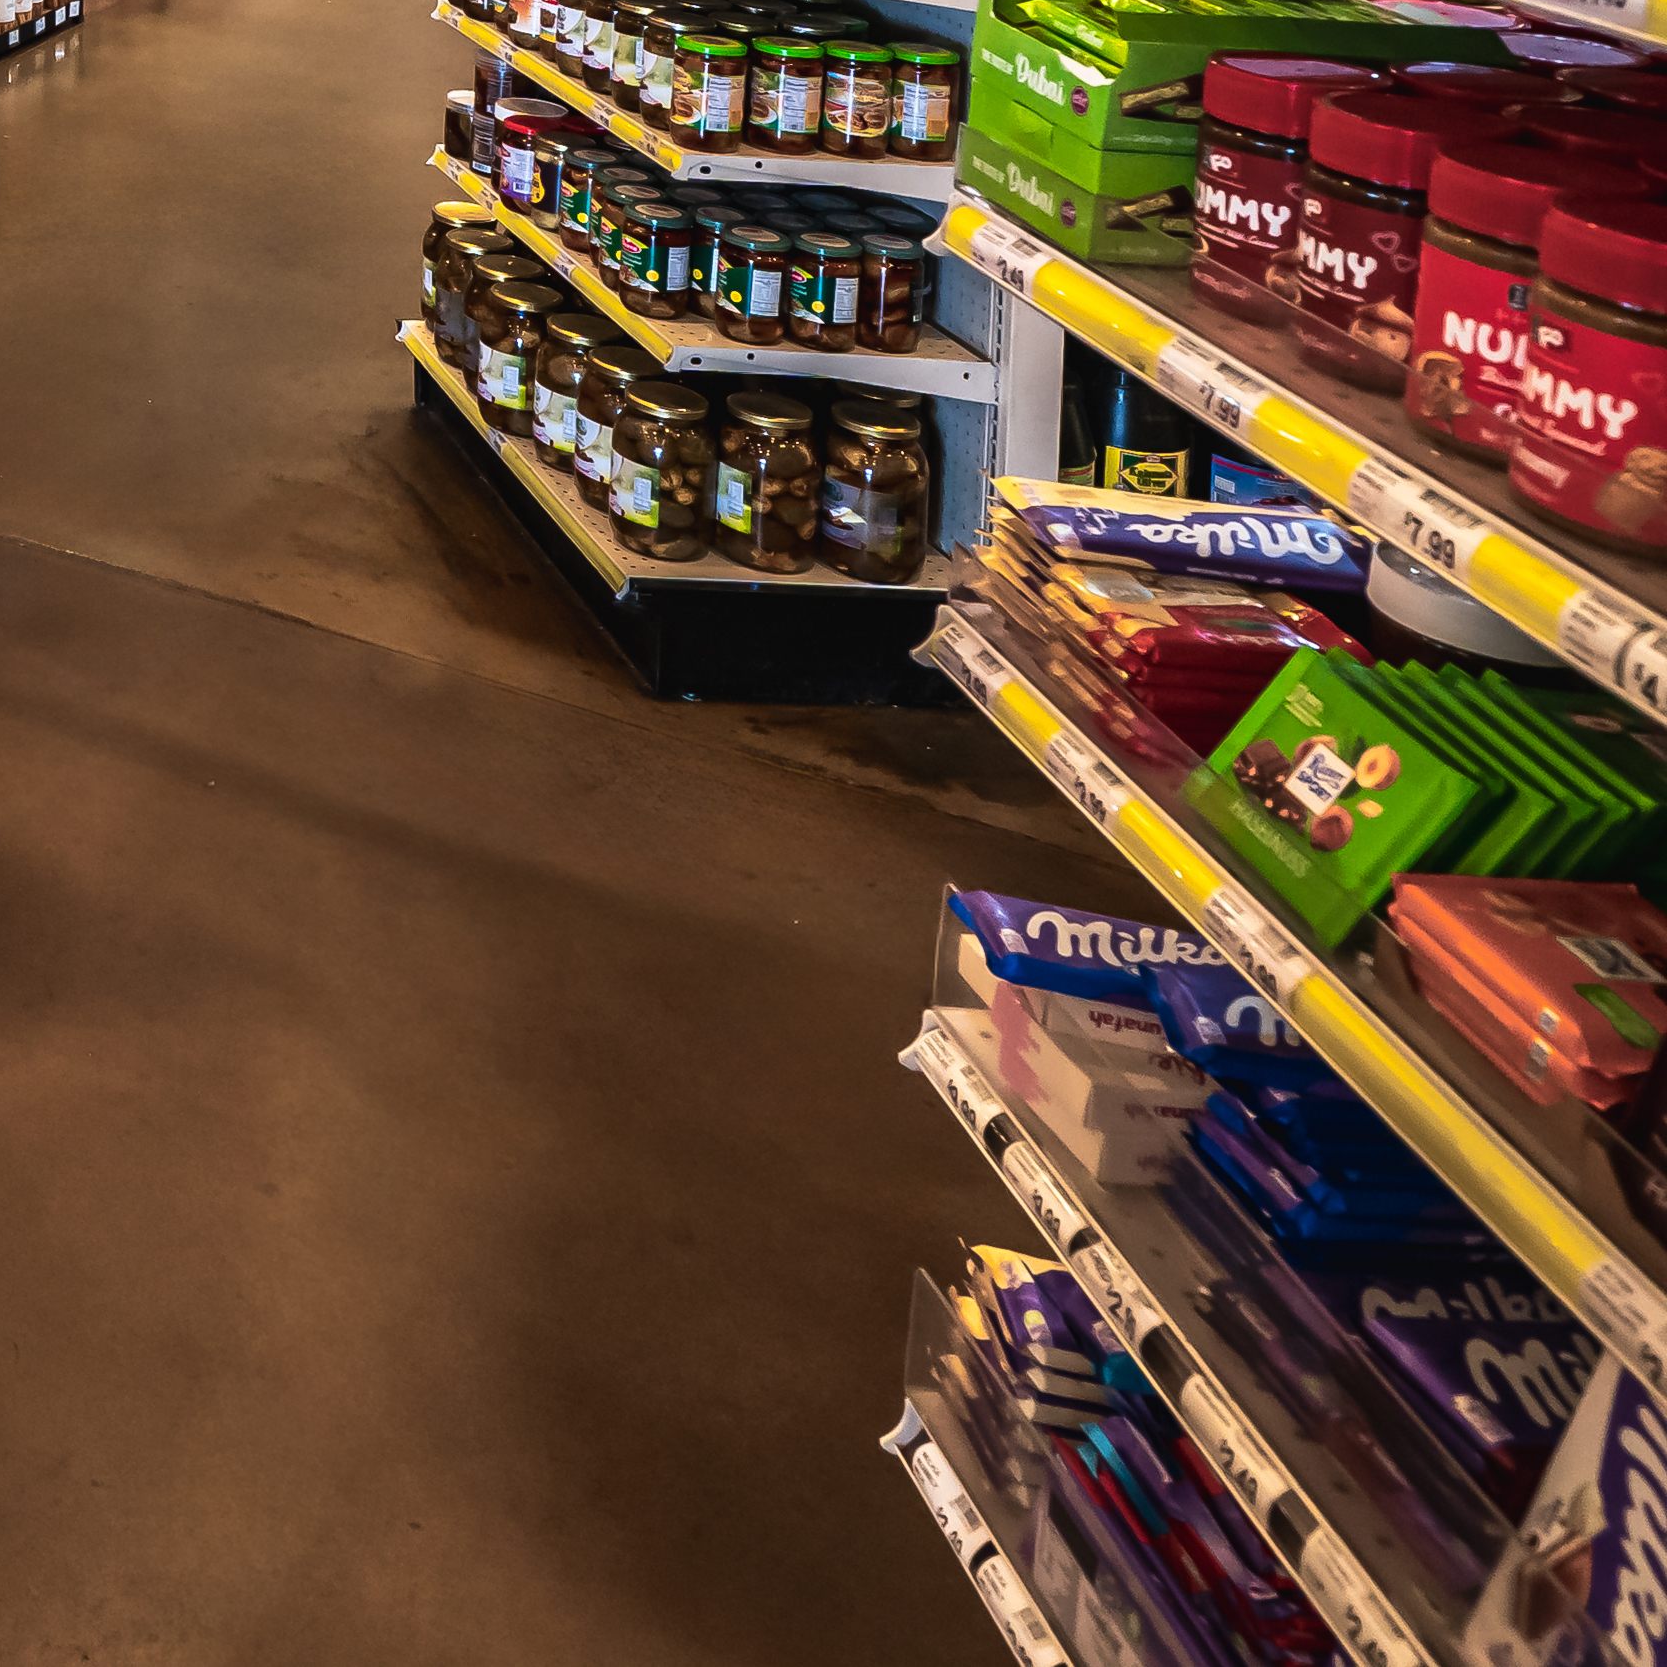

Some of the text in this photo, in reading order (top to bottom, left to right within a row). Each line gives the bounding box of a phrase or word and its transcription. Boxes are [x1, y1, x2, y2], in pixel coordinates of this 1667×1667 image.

[1015, 52, 1065, 106] Dubai
[1007, 161, 1055, 217] Dubai
[1125, 516, 1343, 566] Milka
[1027, 910, 1227, 966] Milka
